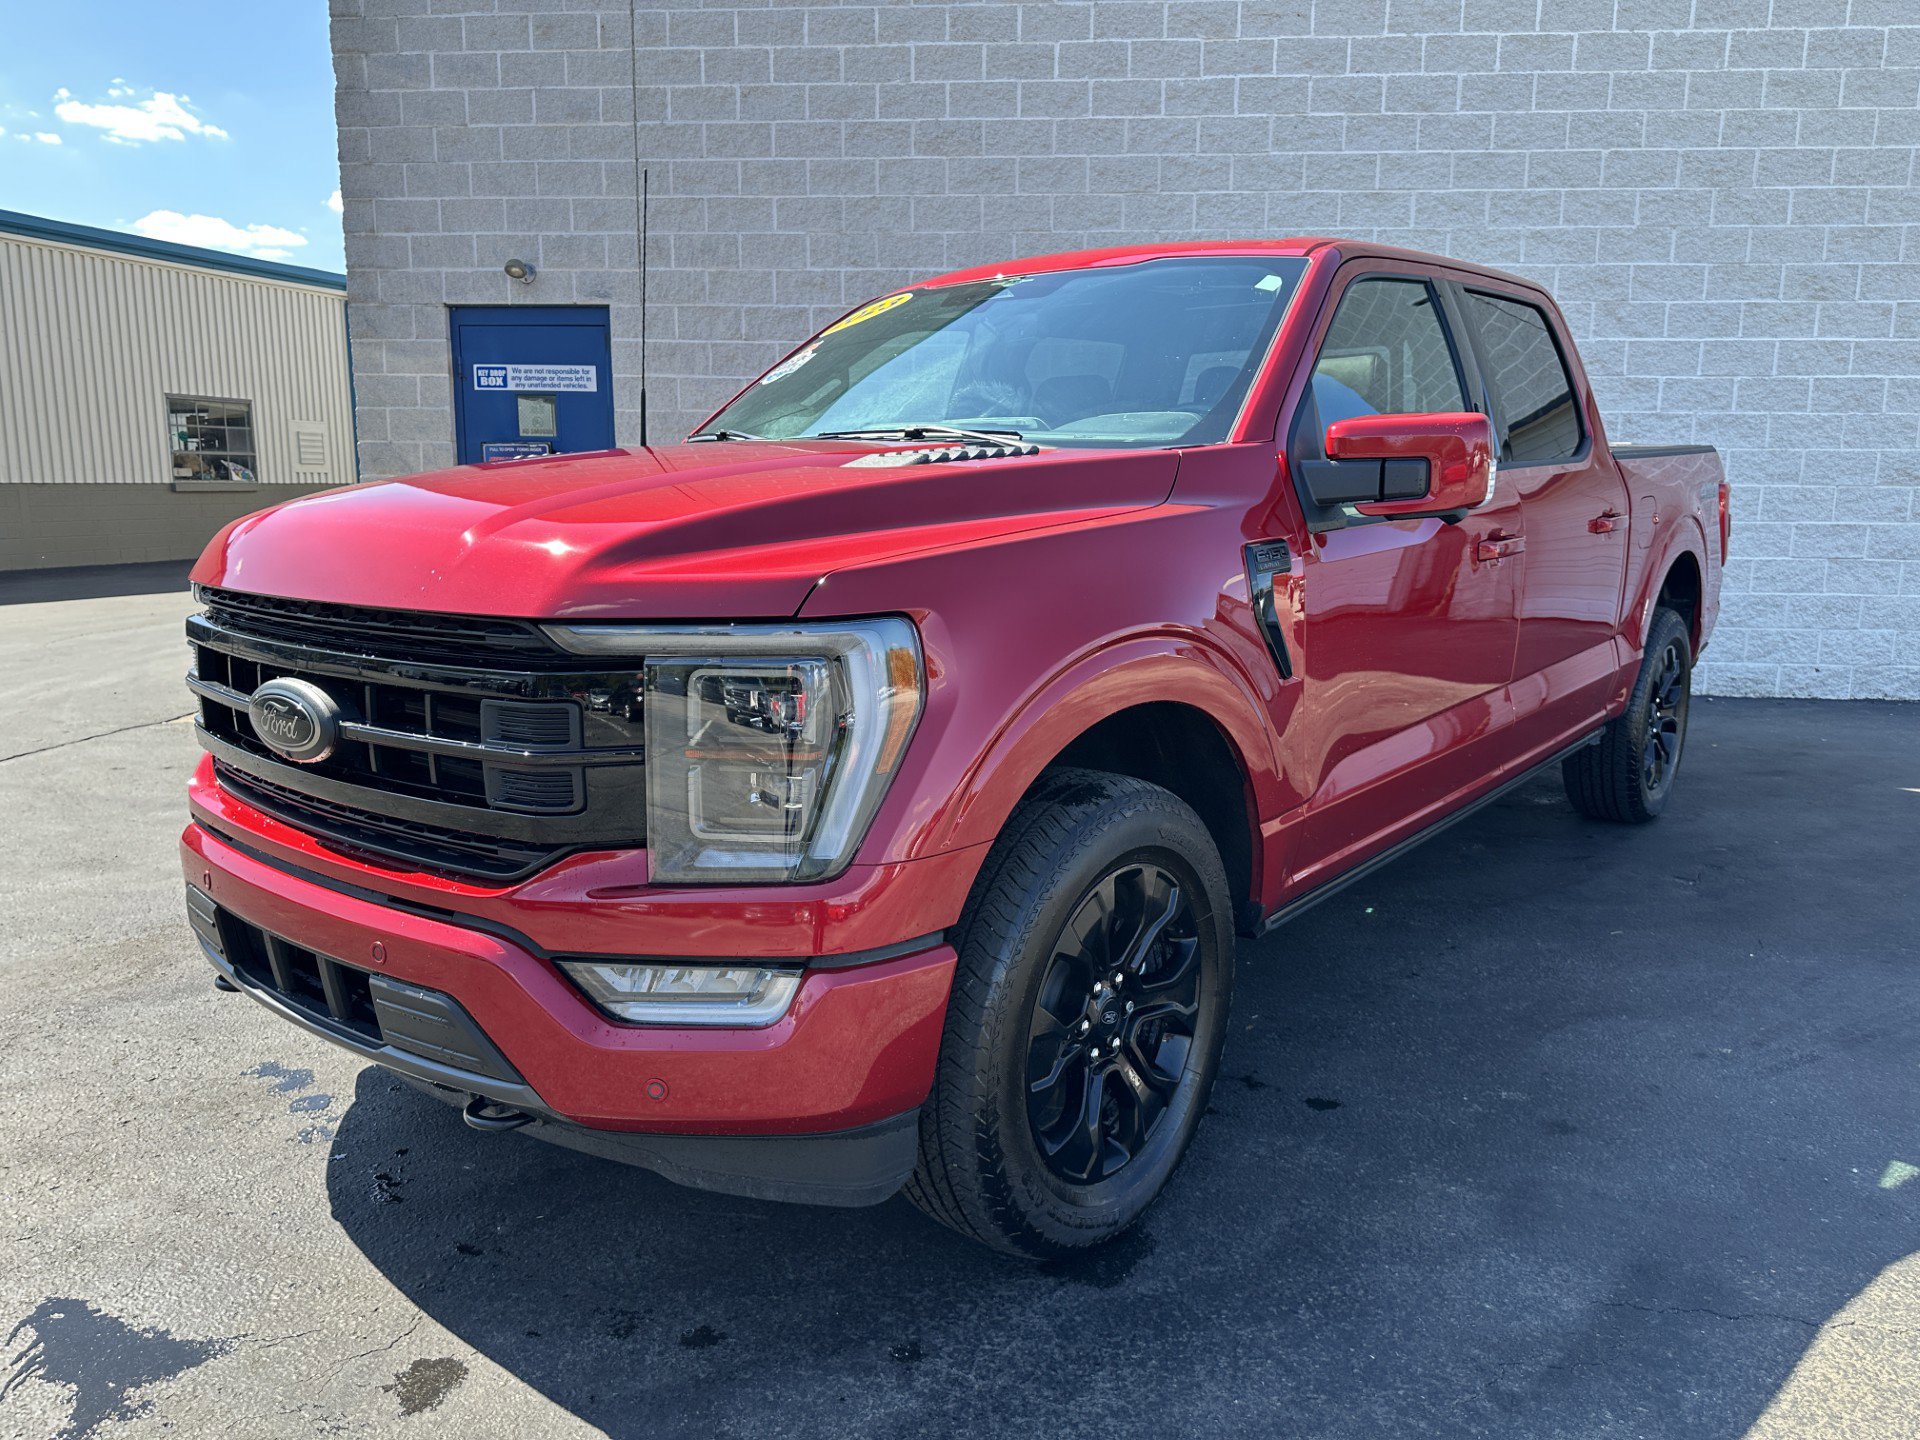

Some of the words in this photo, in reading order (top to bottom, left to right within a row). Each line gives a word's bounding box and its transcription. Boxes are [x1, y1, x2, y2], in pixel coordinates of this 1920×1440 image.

[477, 369, 489, 377] KEY
[490, 369, 506, 377] DROP
[545, 368, 580, 376] responsible
[480, 376, 505, 386] BOX
[511, 375, 522, 383] any
[261, 701, 299, 739] Ford
